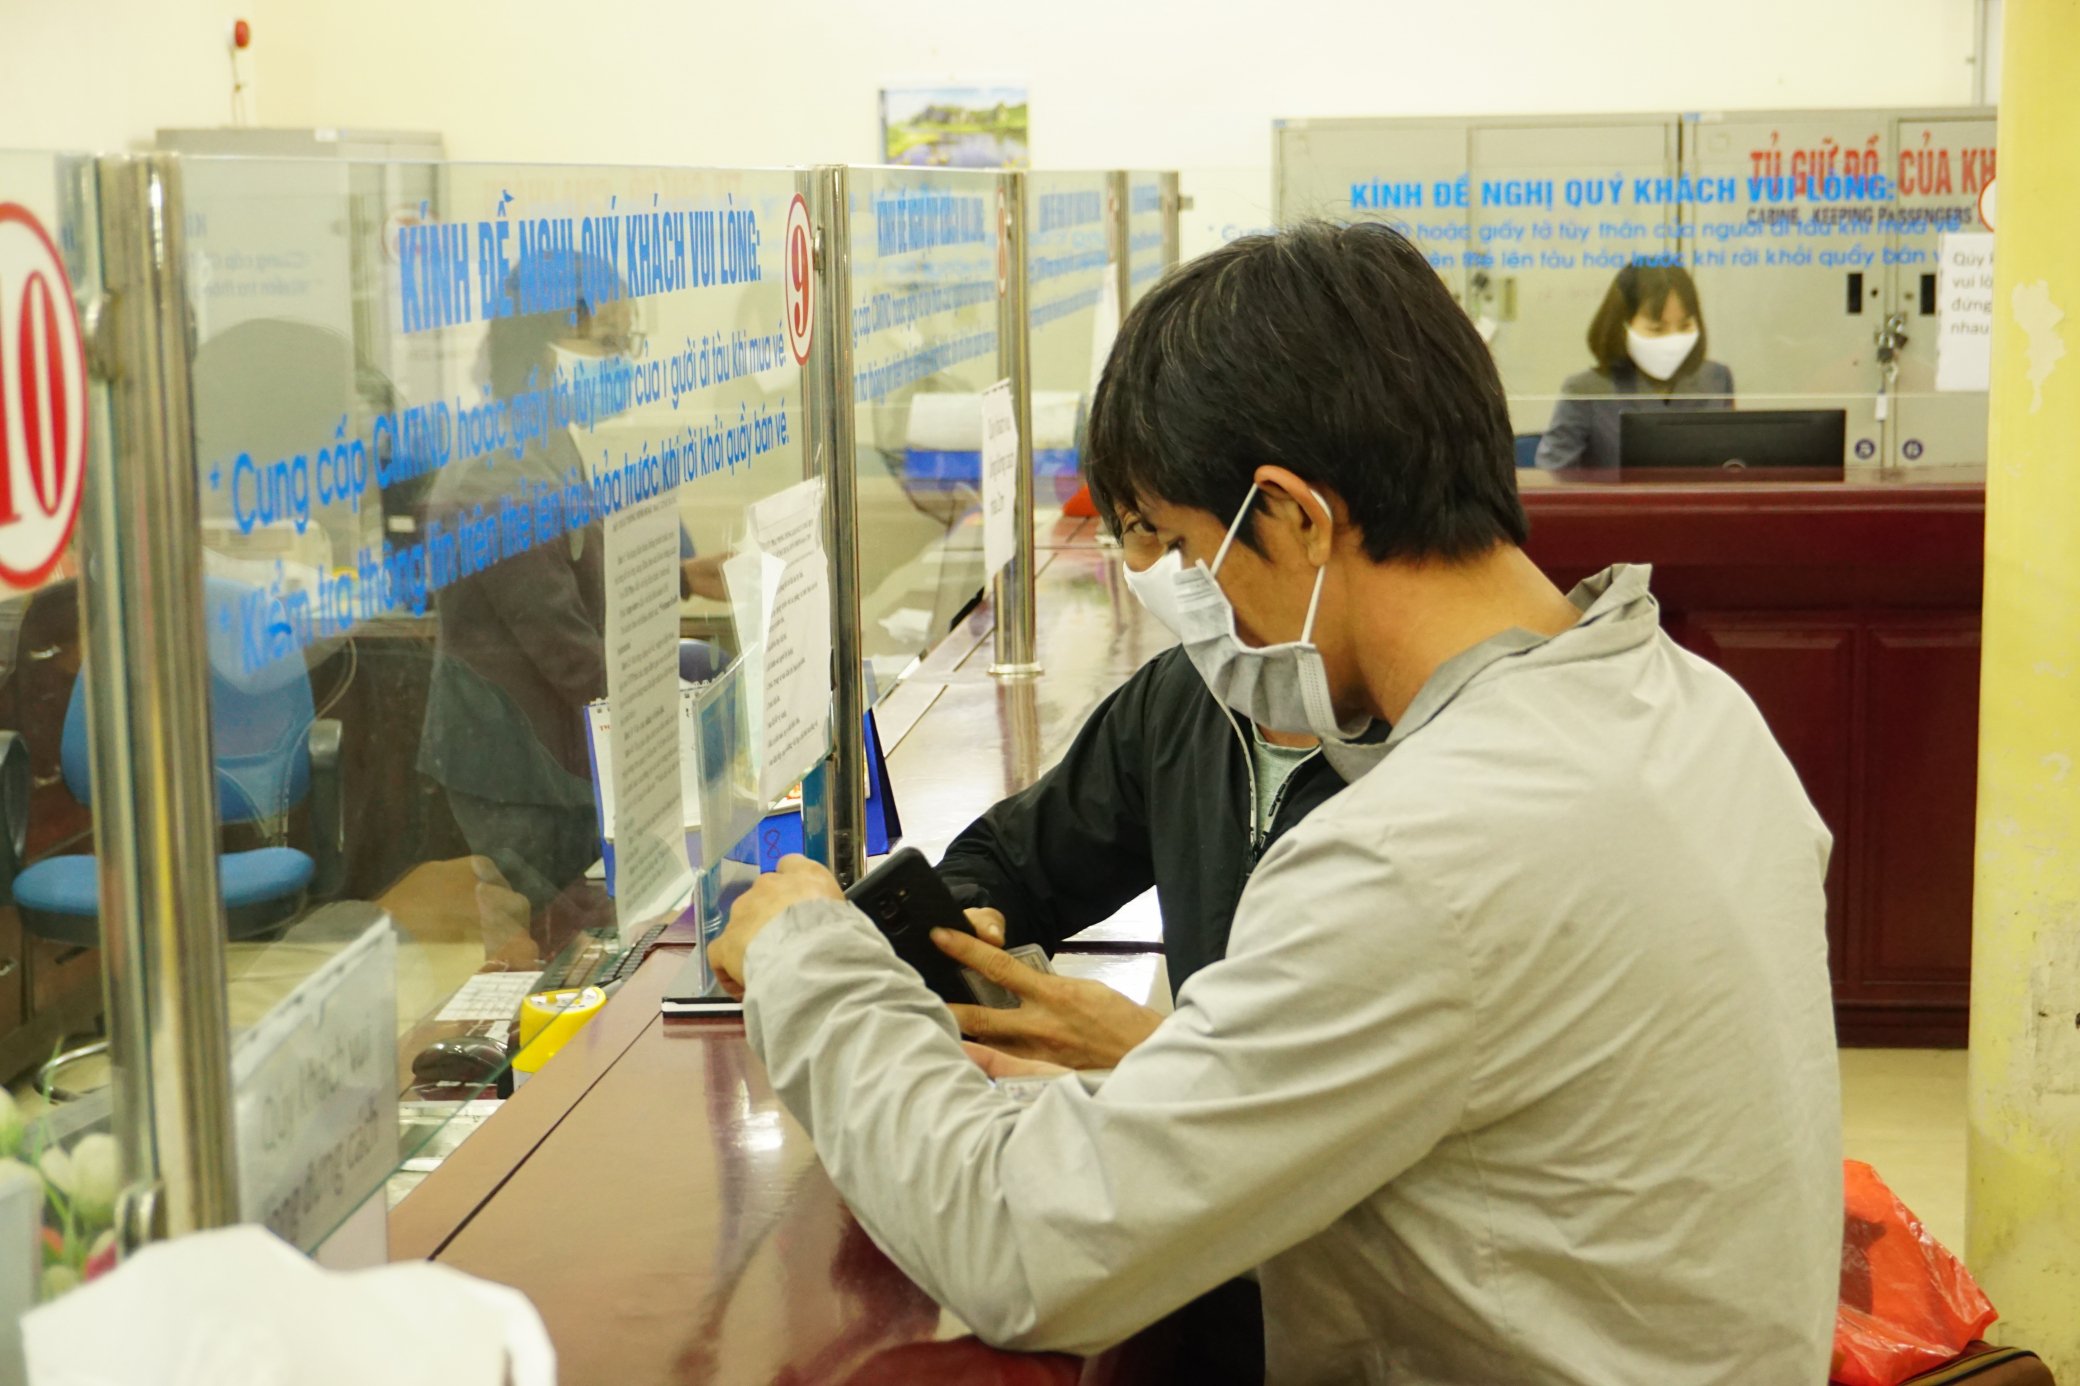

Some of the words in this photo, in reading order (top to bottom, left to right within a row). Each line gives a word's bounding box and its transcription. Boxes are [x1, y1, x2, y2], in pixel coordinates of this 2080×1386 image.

[1351, 176, 1422, 209] KÍNH
[1481, 180, 1553, 212] NGHỊ
[1564, 171, 1624, 207] QUÝ
[1635, 171, 1736, 205] KHÁCH
[1747, 176, 1796, 203] VUI
[1900, 131, 1951, 195] CỦA
[399, 200, 471, 334] KÍNH
[478, 189, 514, 320] ĐỀ
[518, 217, 578, 327] NGHỊ
[582, 195, 620, 317] QUÝ
[626, 193, 687, 298] KHÁCH
[689, 210, 716, 288] VUI
[719, 193, 762, 286] LÒNG:
[791, 224, 810, 339] 9
[1693, 247, 1725, 267] khi
[232, 452, 309, 535] Cung
[317, 413, 367, 514] cấp
[457, 383, 509, 471] hoặc
[511, 364, 549, 460] giấy
[600, 355, 632, 417] thân
[635, 340, 661, 406] của
[700, 335, 712, 389] đi
[712, 330, 731, 385] tàu
[732, 329, 748, 379] khi
[749, 334, 772, 374] mua
[592, 449, 622, 521] hỏa
[624, 441, 659, 506] trước
[662, 436, 681, 491] khi
[683, 426, 699, 482] rời
[700, 414, 724, 476] khỏi
[727, 401, 753, 476] quầy
[755, 402, 774, 455] bán
